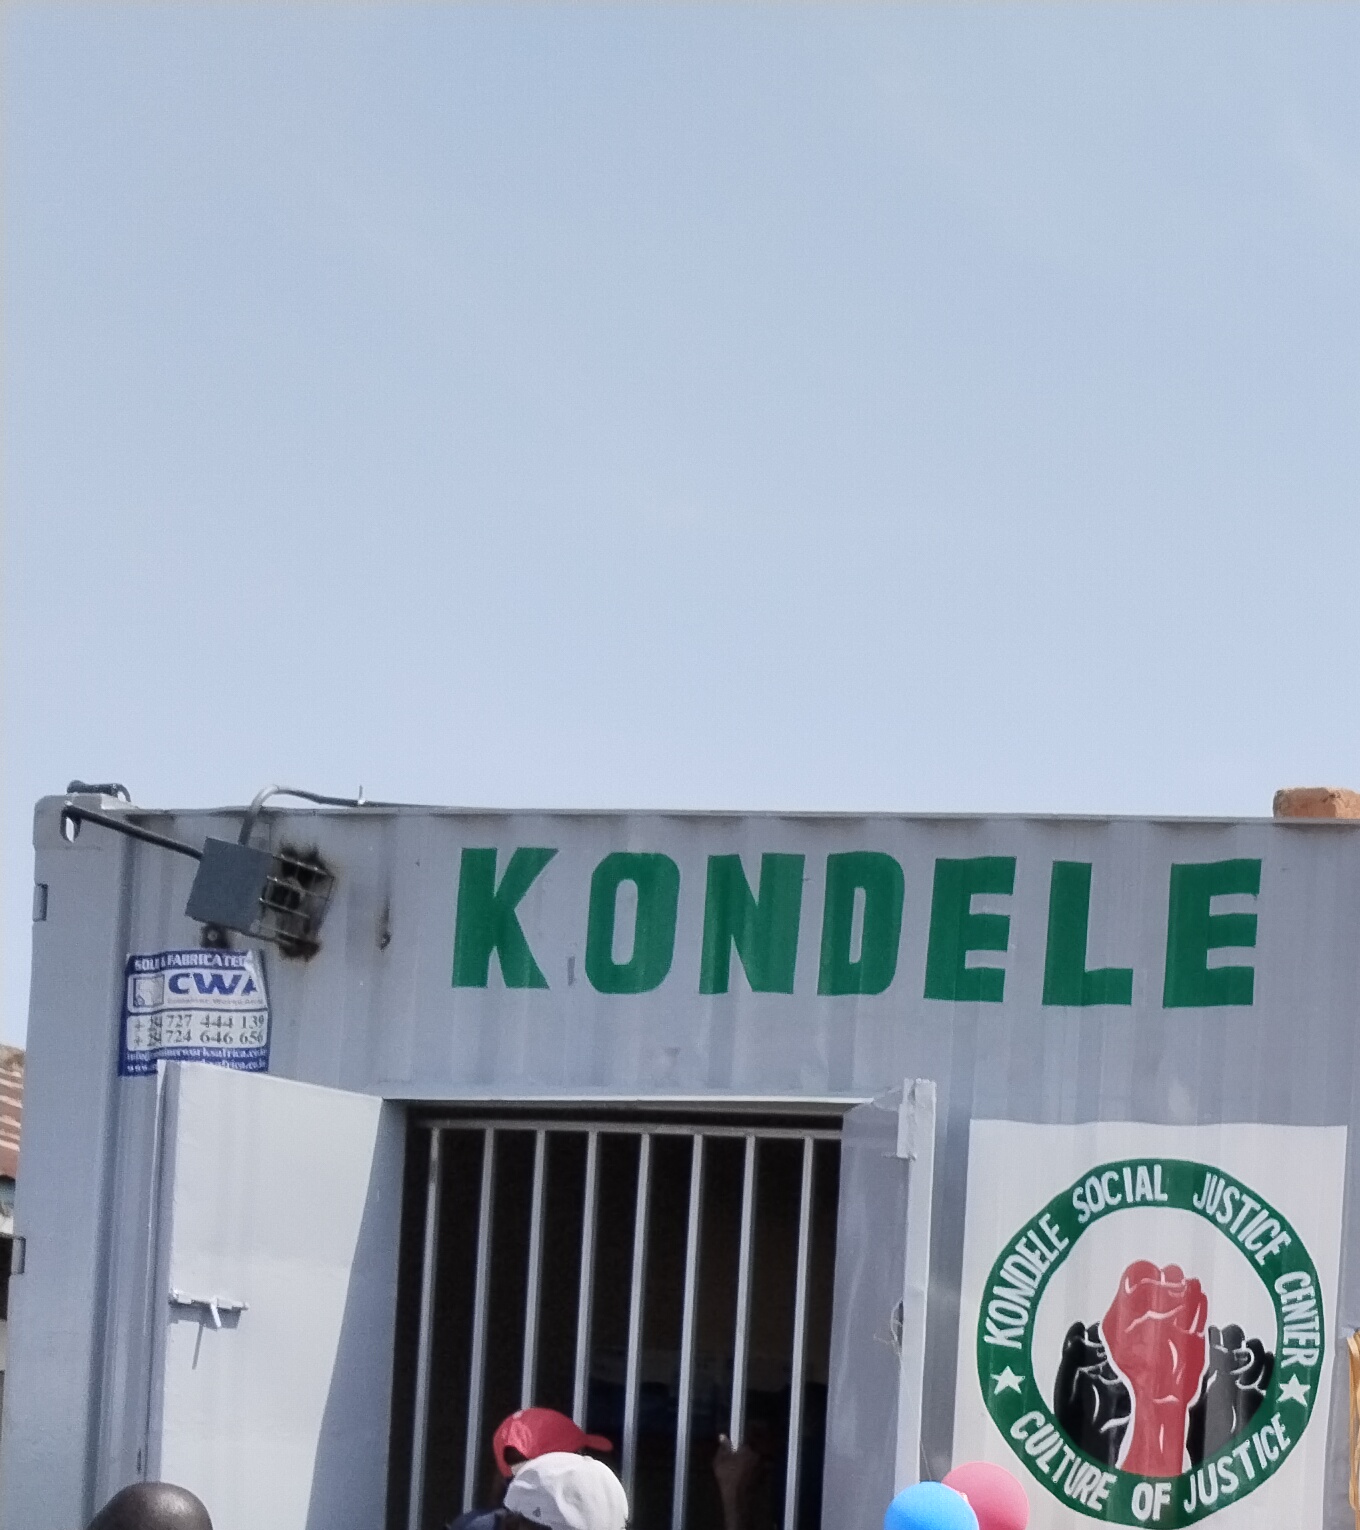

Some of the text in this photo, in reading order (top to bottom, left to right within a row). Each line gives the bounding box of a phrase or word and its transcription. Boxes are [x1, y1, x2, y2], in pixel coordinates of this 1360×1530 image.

[451, 846, 1263, 1009] KONDELE
[984, 1164, 1321, 1369] KONDELE SOCIAL JUSTICE CENTER
[1010, 1411, 1292, 1522] CULTURE OF JUSTICE
